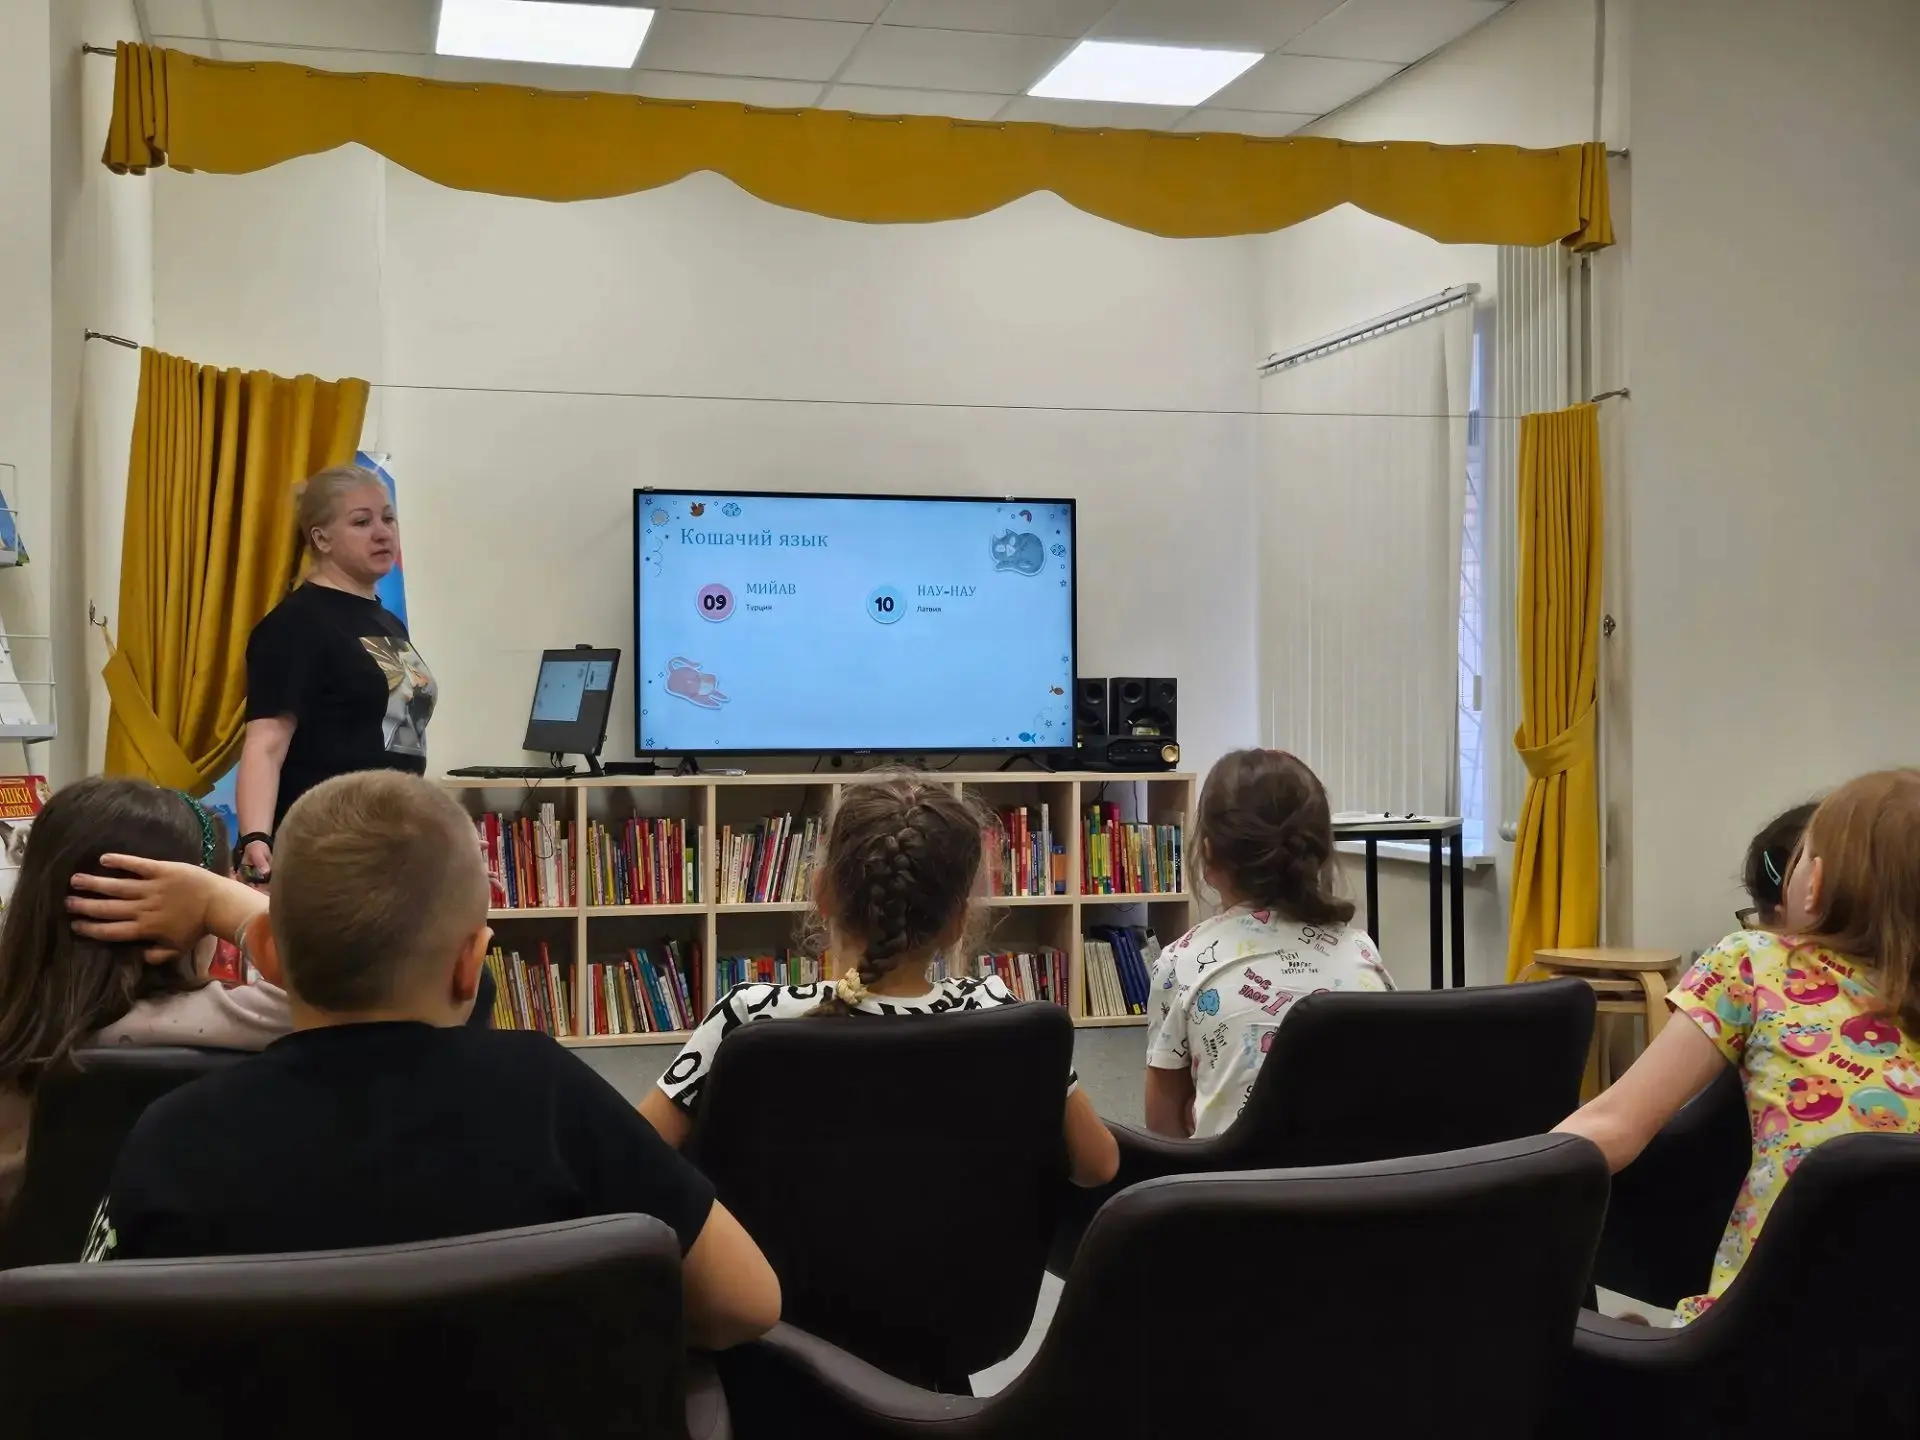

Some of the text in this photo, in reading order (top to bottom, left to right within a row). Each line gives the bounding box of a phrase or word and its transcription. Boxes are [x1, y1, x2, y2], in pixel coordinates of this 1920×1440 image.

[681, 528, 829, 547] Кошачий язык
[746, 580, 796, 595] МИЙАВ
[917, 584, 977, 597] НАУ-НАУ
[703, 594, 727, 611] 09
[746, 603, 772, 612] Турция
[875, 596, 895, 613] 10
[917, 605, 942, 613] Латвия
